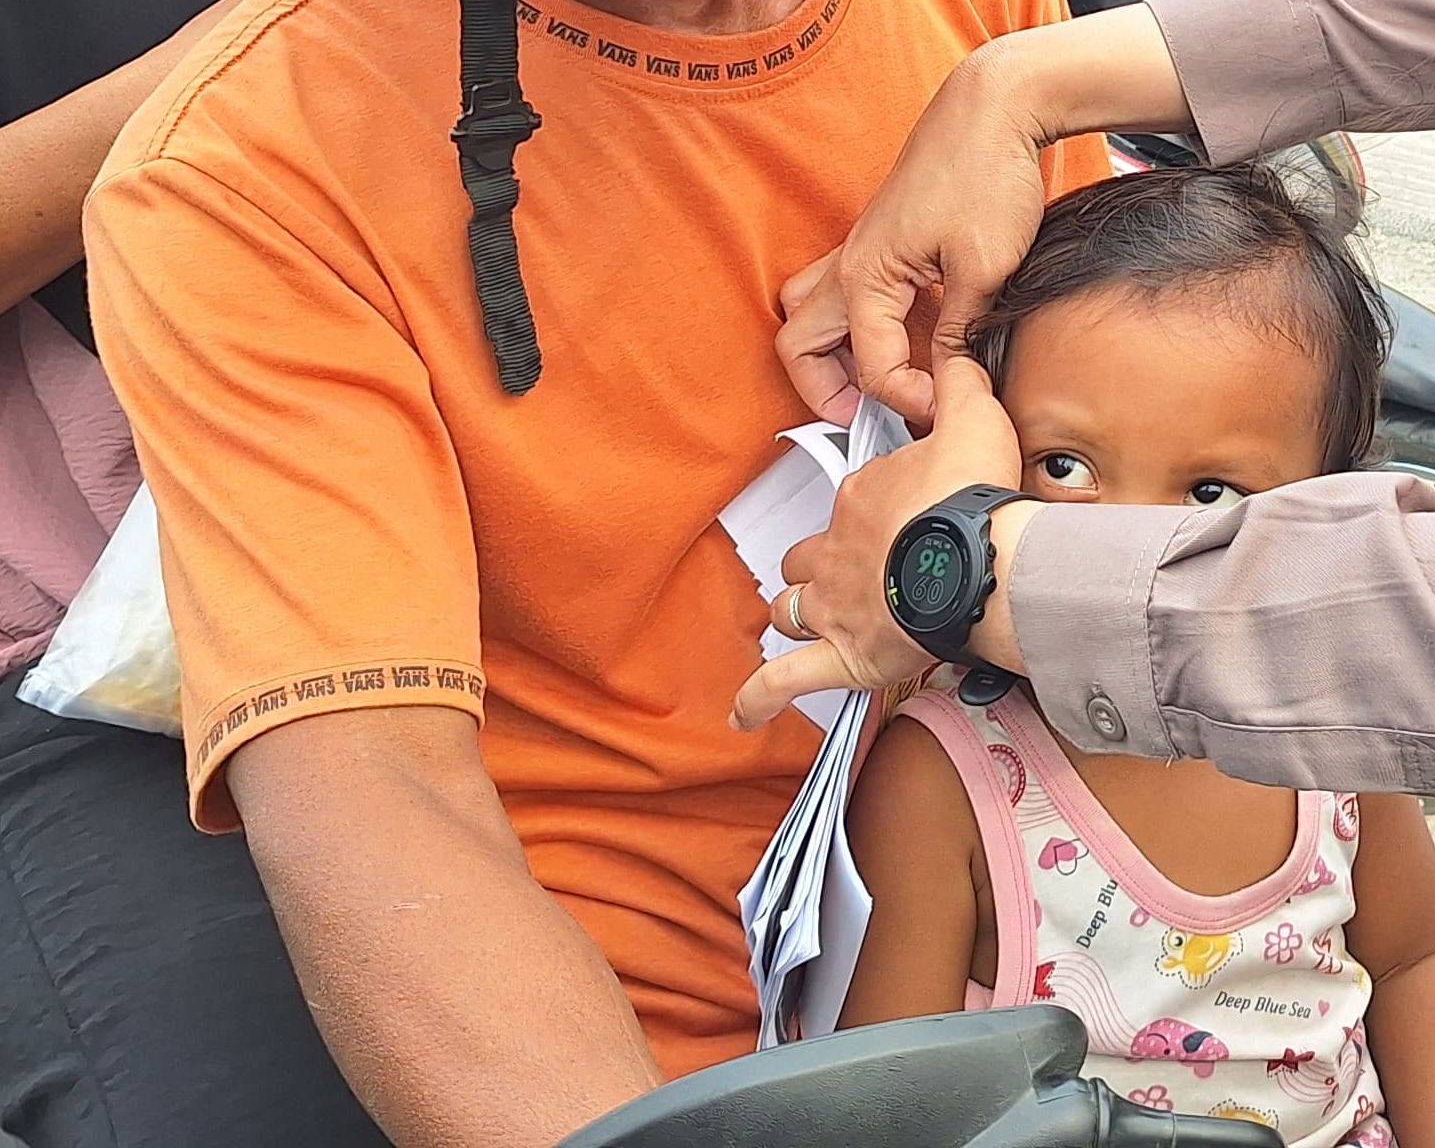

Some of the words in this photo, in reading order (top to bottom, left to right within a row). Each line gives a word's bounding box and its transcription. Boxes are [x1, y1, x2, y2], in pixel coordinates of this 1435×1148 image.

[547, 17, 590, 48] VANS
[598, 39, 638, 68] VANS
[646, 55, 681, 78] VANS
[687, 63, 720, 81] VANS
[726, 59, 758, 80] VANS
[762, 43, 796, 72] VANS
[797, 20, 822, 52] VANS
[226, 702, 248, 734] VANS
[251, 686, 288, 717] VANS
[294, 674, 336, 702] VANS
[342, 667, 385, 692] VANS
[392, 666, 430, 688] VANS
[436, 667, 465, 691] VANS
[1076, 910, 1107, 949] Deep
[1214, 990, 1251, 1014] Deep
[1254, 996, 1287, 1015] Blue
[1288, 1001, 1312, 1019] Sea
